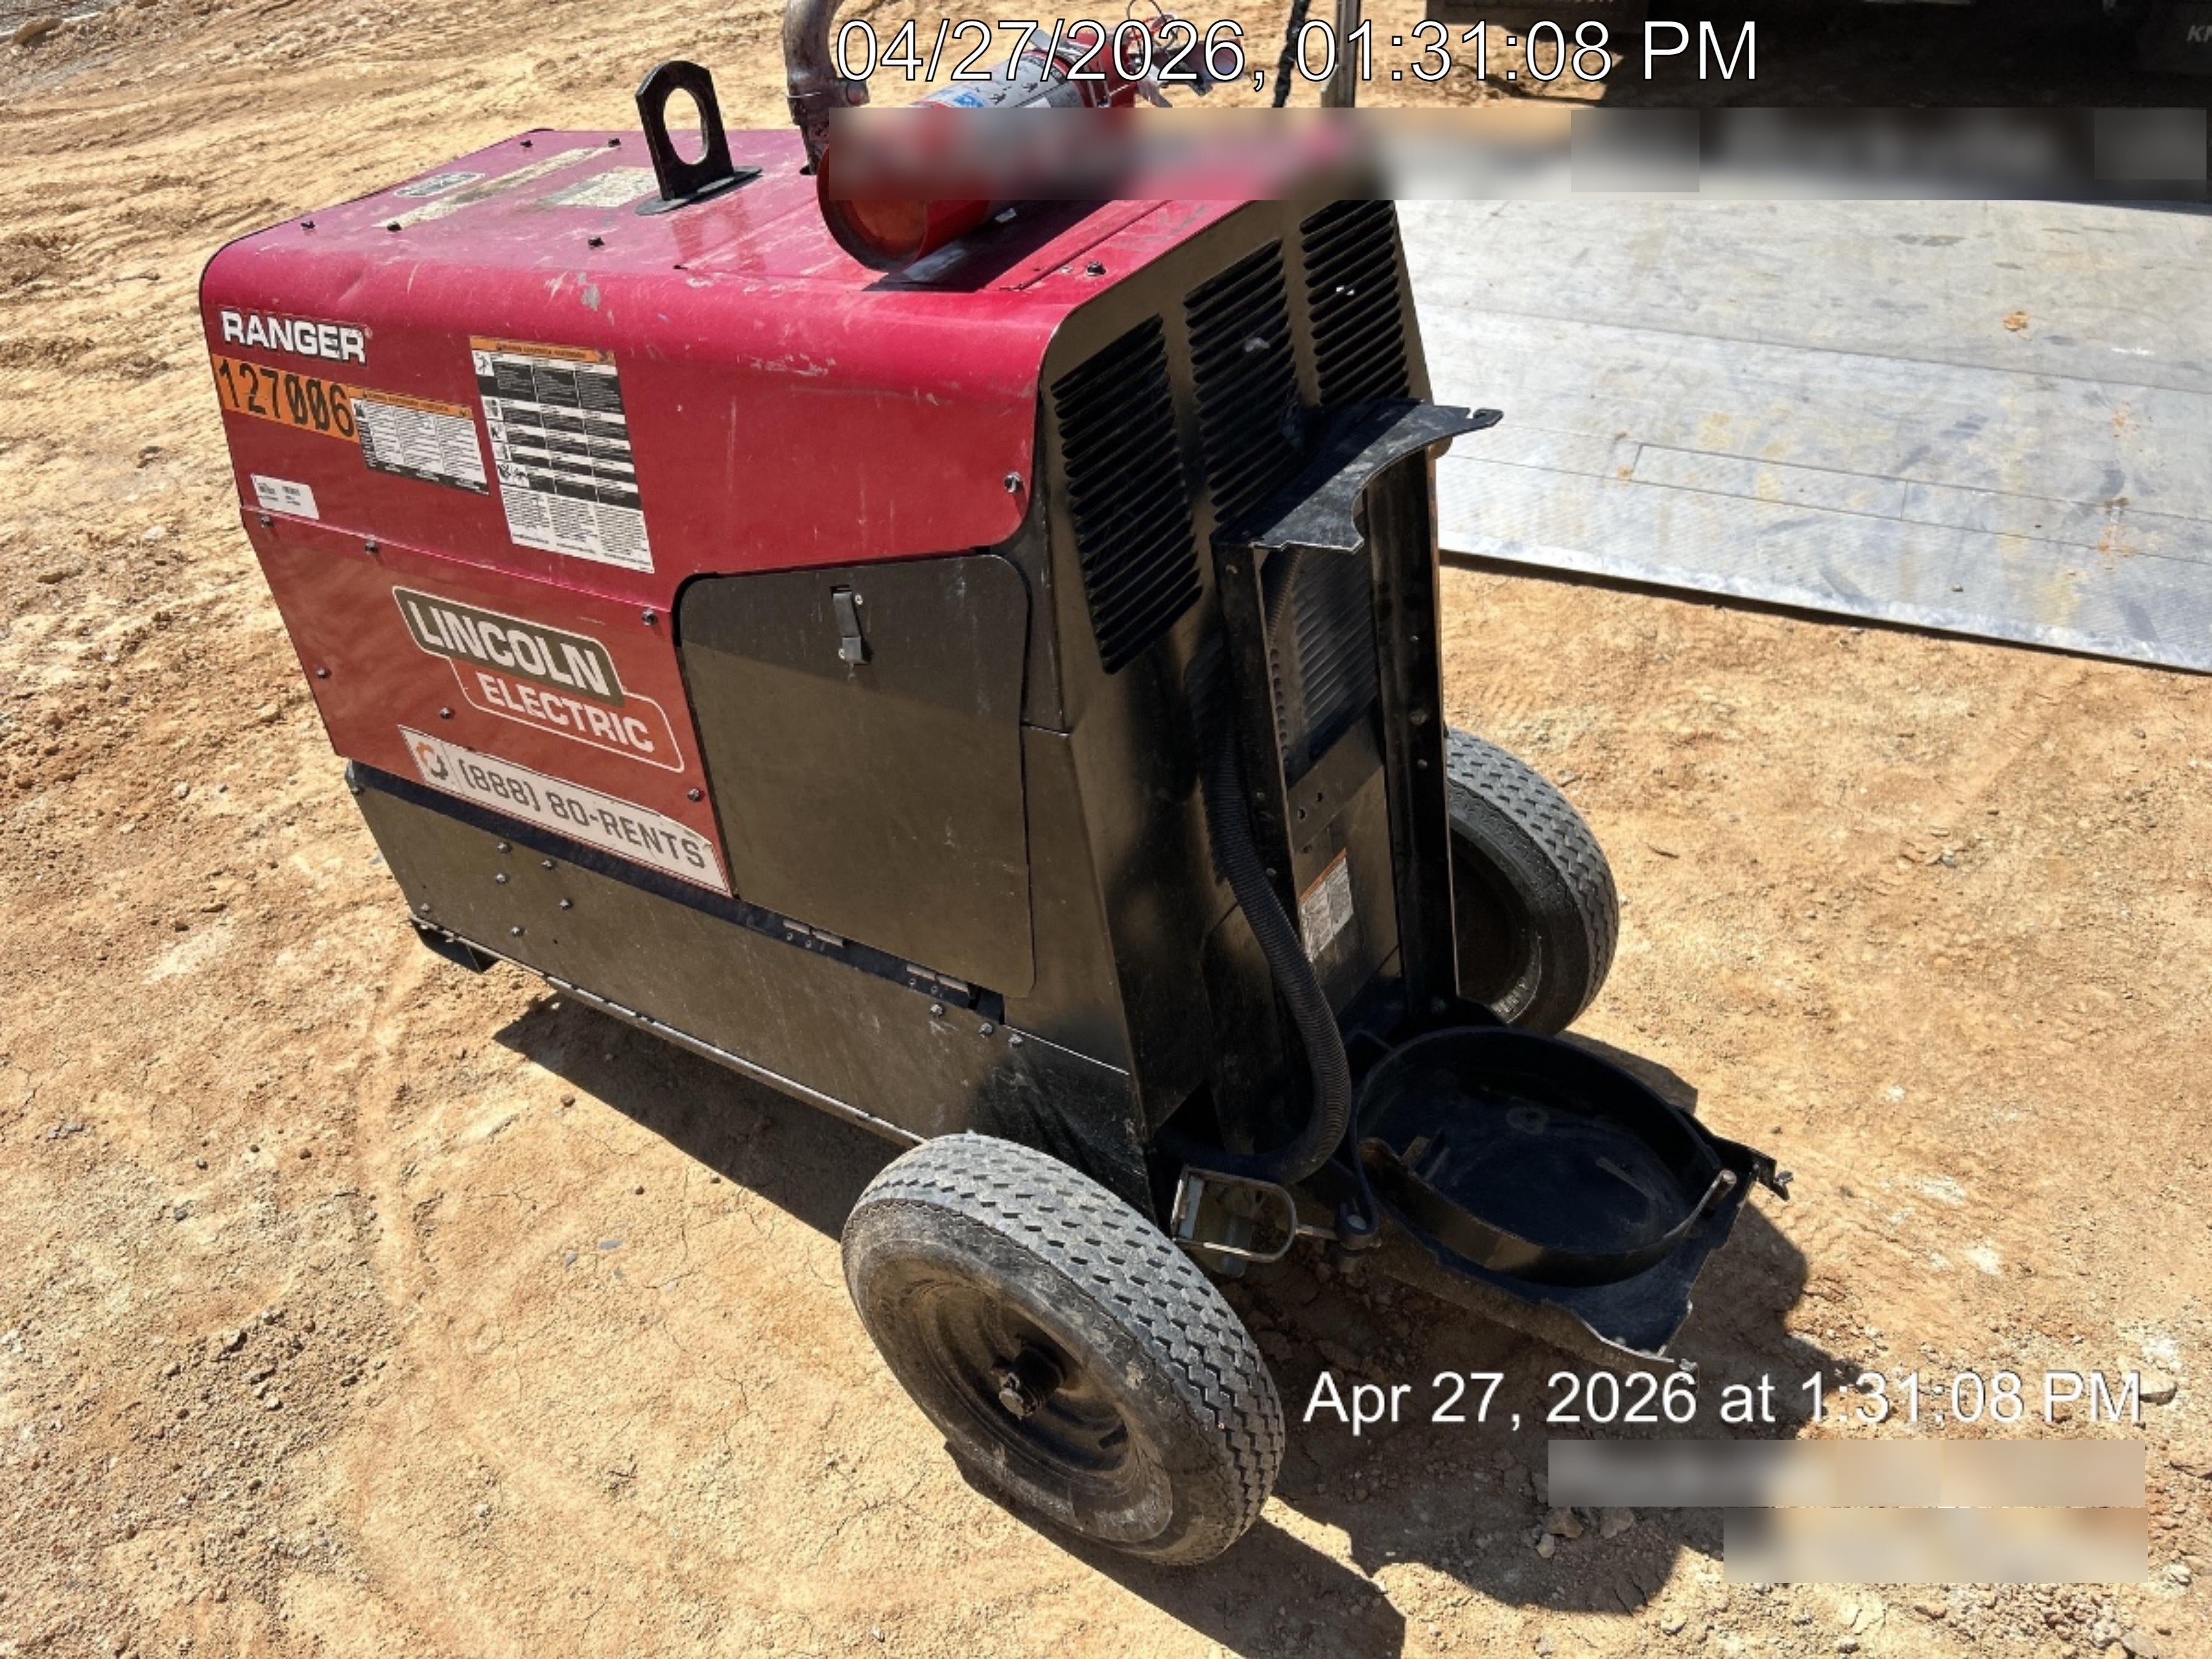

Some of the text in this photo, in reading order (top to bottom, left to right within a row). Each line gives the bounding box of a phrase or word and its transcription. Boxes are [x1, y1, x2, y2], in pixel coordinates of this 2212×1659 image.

[219, 309, 368, 366] RANGER
[218, 358, 355, 438] 127006
[407, 600, 611, 696] LINCOLN
[476, 671, 654, 753] ELECTRIC
[457, 758, 706, 869] (888) 80-RENTS
